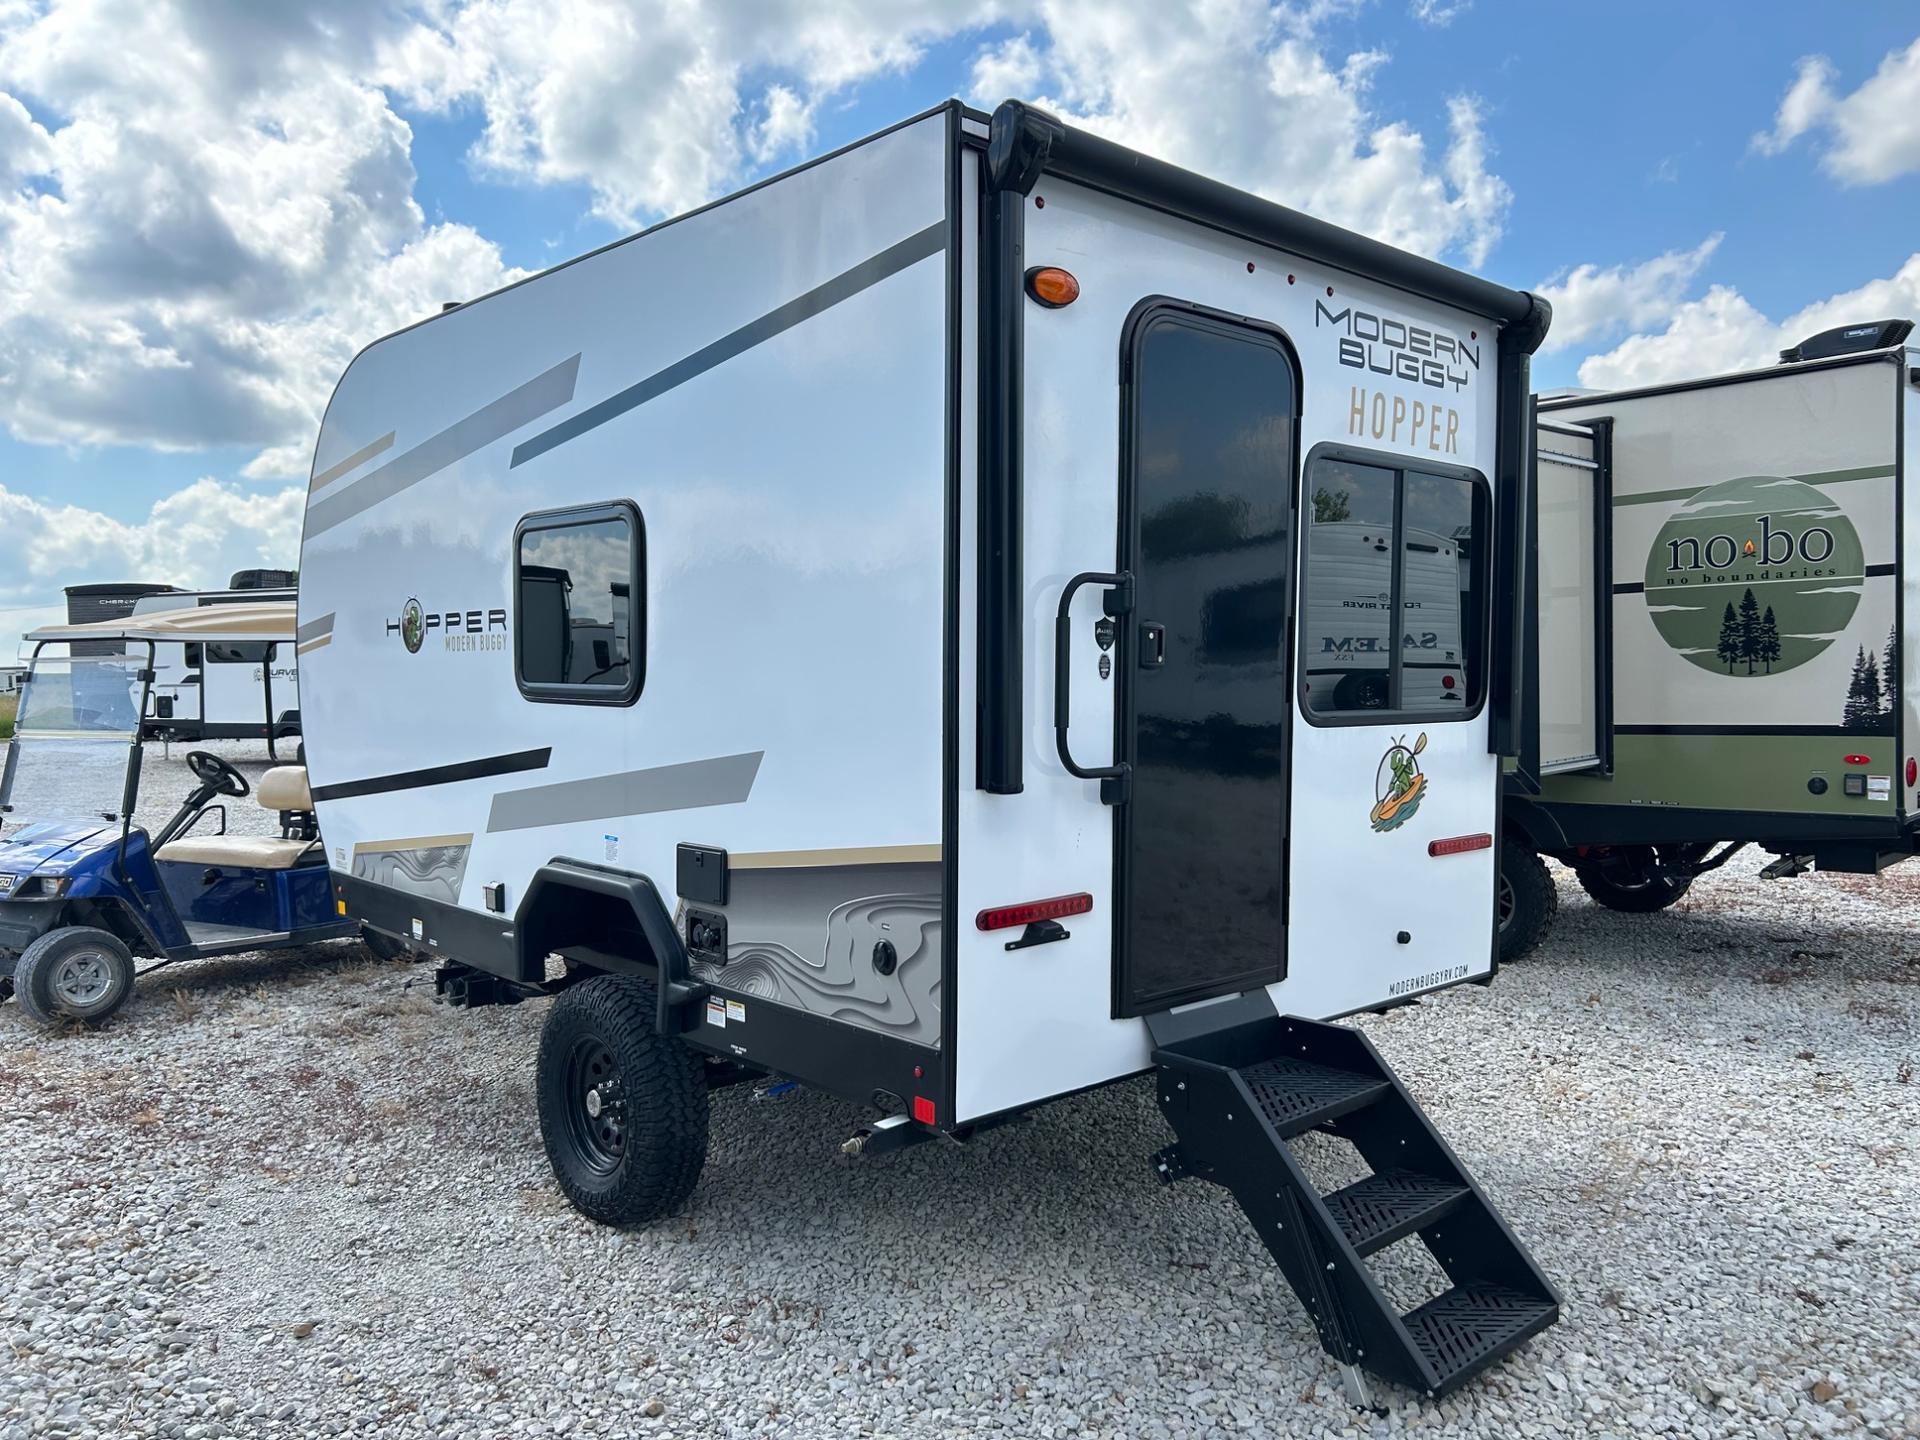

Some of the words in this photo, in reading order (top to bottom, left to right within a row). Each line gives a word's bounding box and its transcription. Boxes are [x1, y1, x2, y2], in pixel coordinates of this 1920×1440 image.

[1315, 298, 1480, 370] MODERN
[1339, 337, 1468, 392] BUGGY
[1349, 386, 1459, 455] HOPPER
[1666, 577, 1689, 585] no
[1703, 567, 1837, 583] boundaries
[386, 597, 507, 654] HOPPER
[445, 637, 476, 652] MODERN
[480, 634, 507, 650] BUGGY
[1389, 964, 1468, 996] MODERNBUGGYRV.COM
